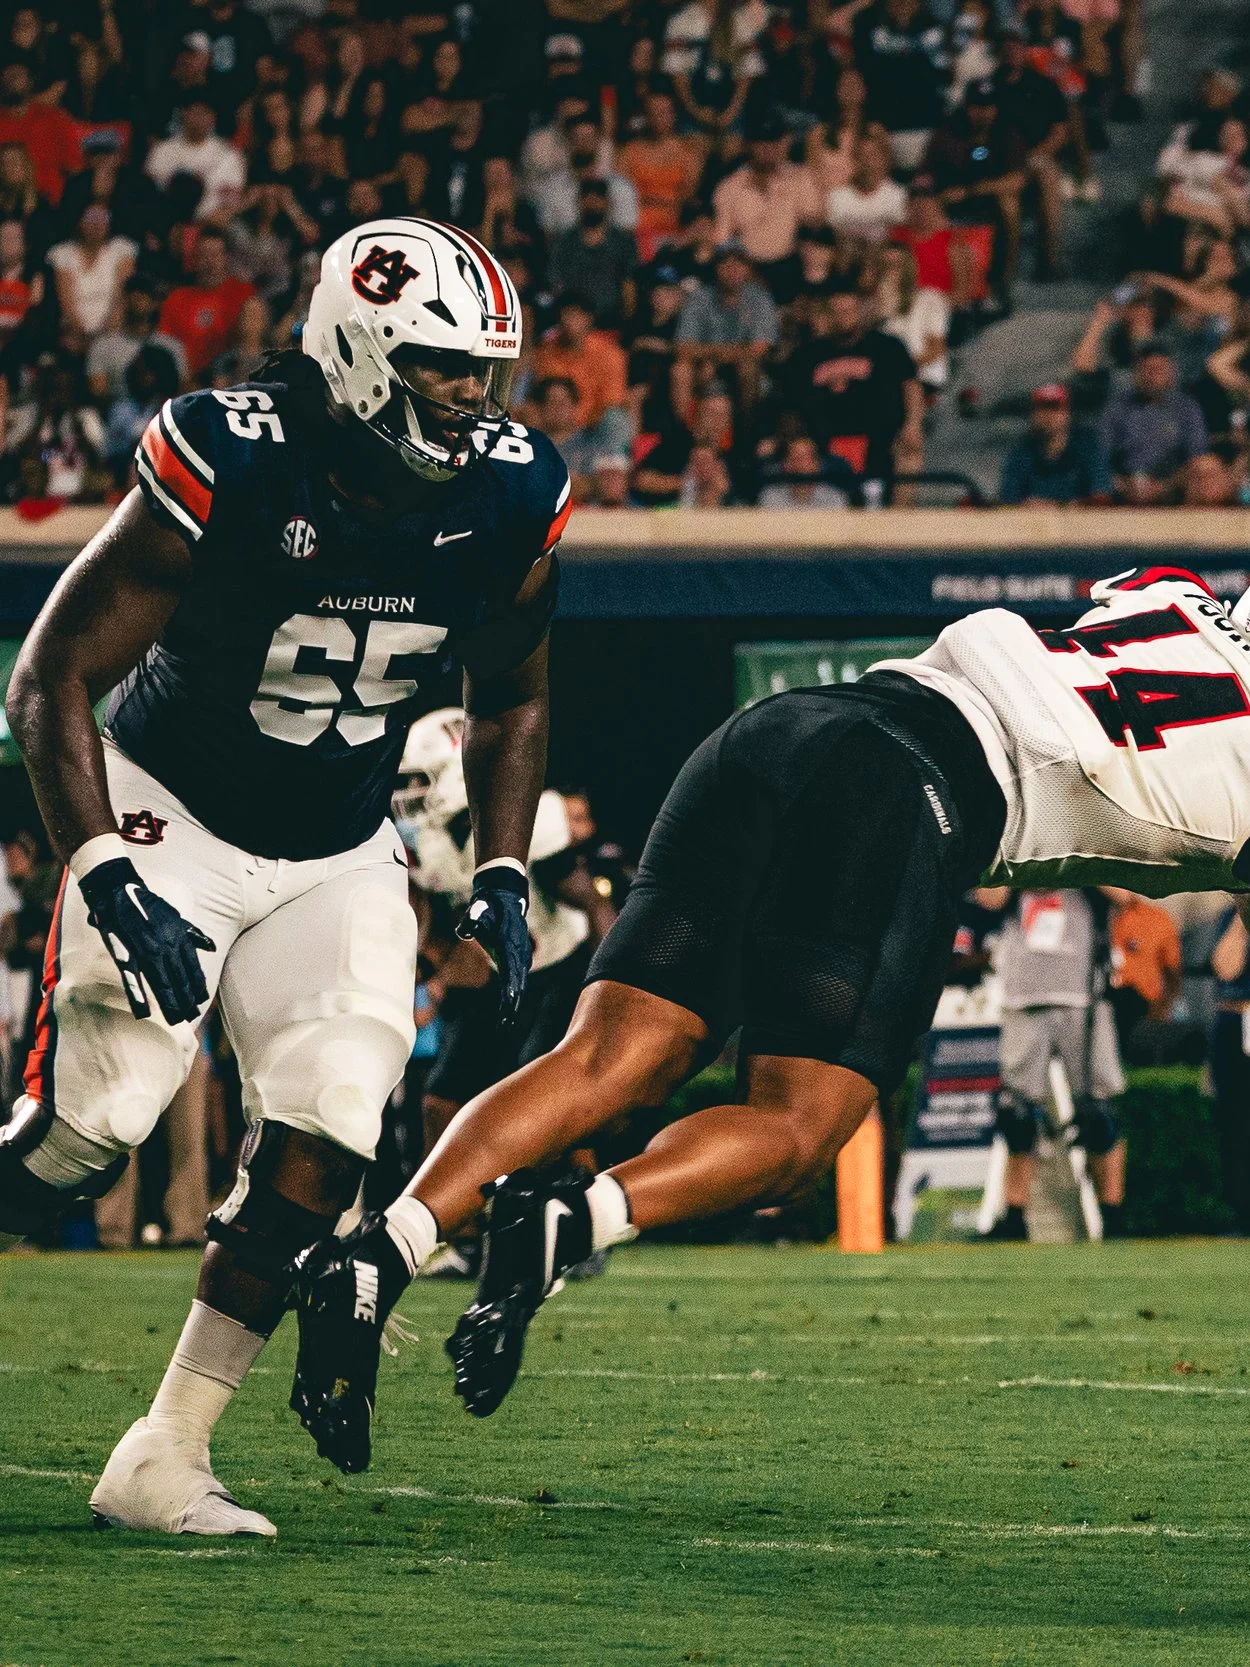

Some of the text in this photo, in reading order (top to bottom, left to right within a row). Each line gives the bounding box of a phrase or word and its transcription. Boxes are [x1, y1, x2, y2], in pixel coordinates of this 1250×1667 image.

[485, 338, 516, 348] TIGERS
[211, 390, 285, 442] 65
[281, 519, 317, 558] SEC
[317, 595, 415, 613] AUBURN
[250, 613, 448, 746] 65
[923, 784, 952, 834] CARDINALS
[353, 1259, 379, 1324] NIKE
